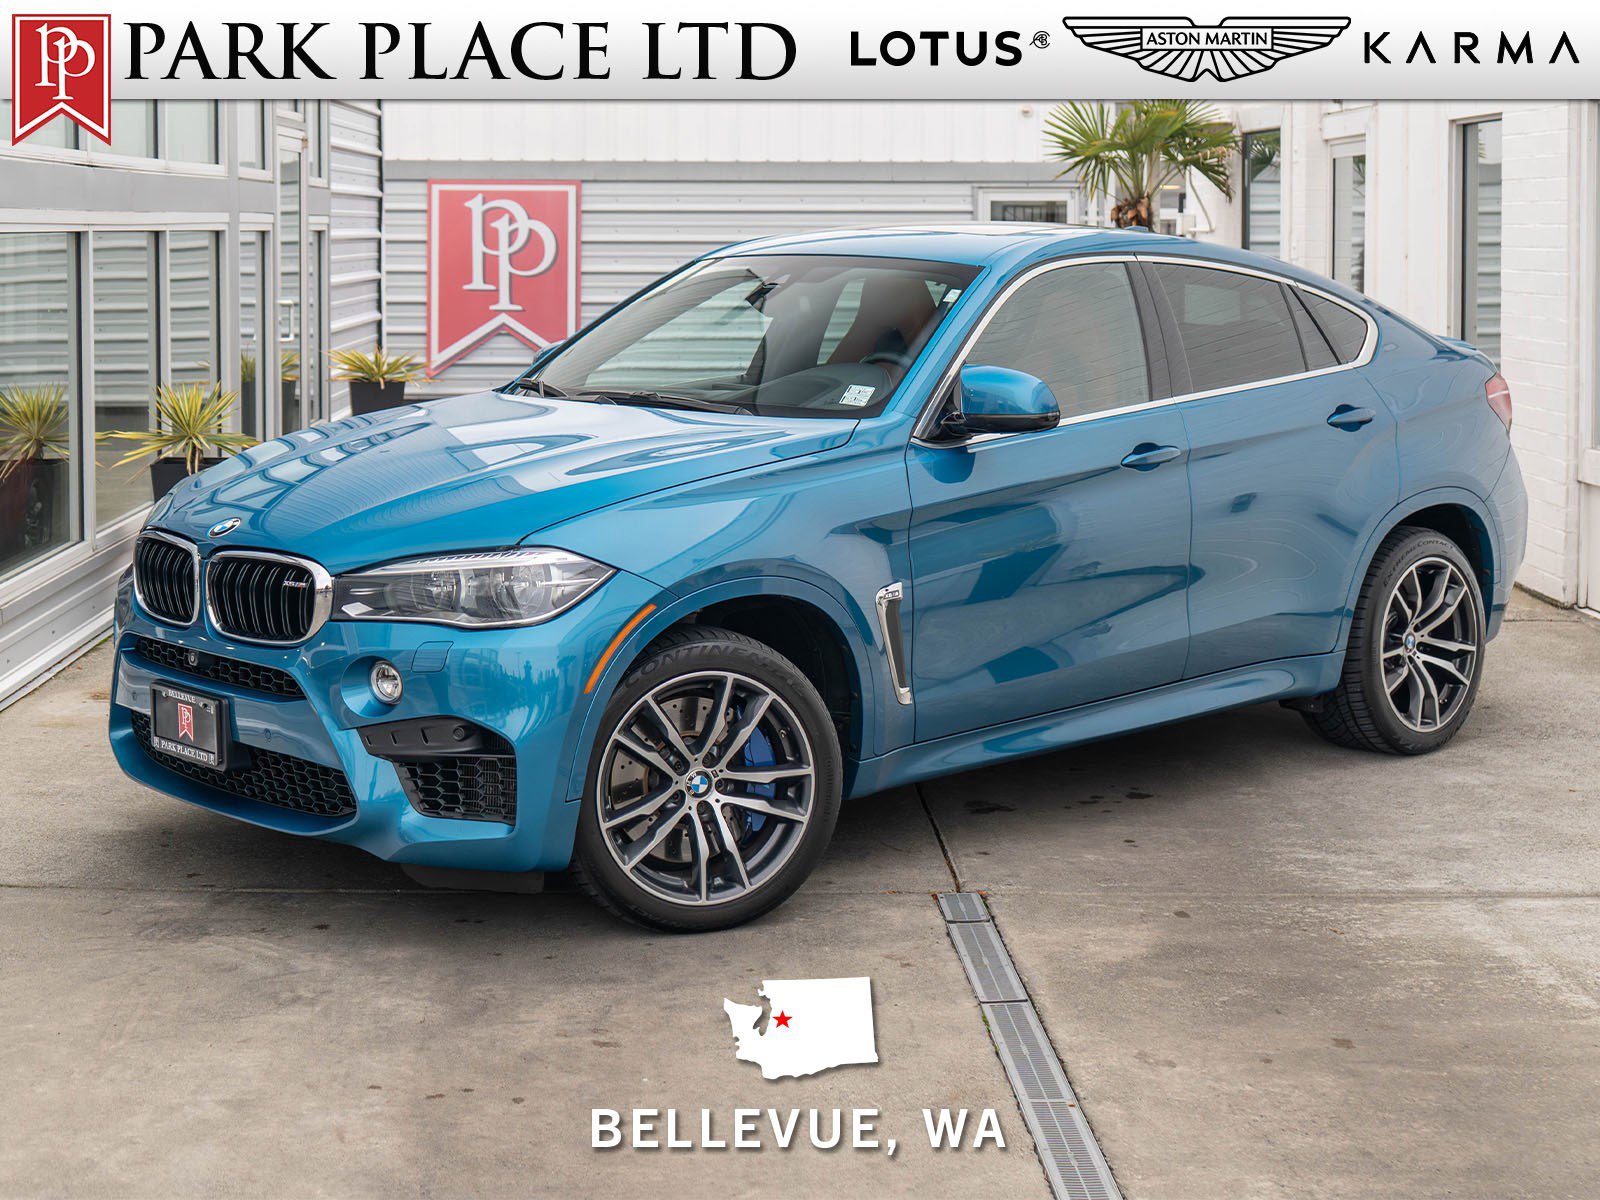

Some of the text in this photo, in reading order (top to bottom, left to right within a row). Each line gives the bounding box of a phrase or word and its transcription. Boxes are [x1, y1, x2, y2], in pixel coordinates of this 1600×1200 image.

[168, 689, 197, 704] BELLEVUE
[161, 740, 177, 752] PARK
[177, 744, 196, 758] PLACE
[196, 750, 208, 762] LTD
